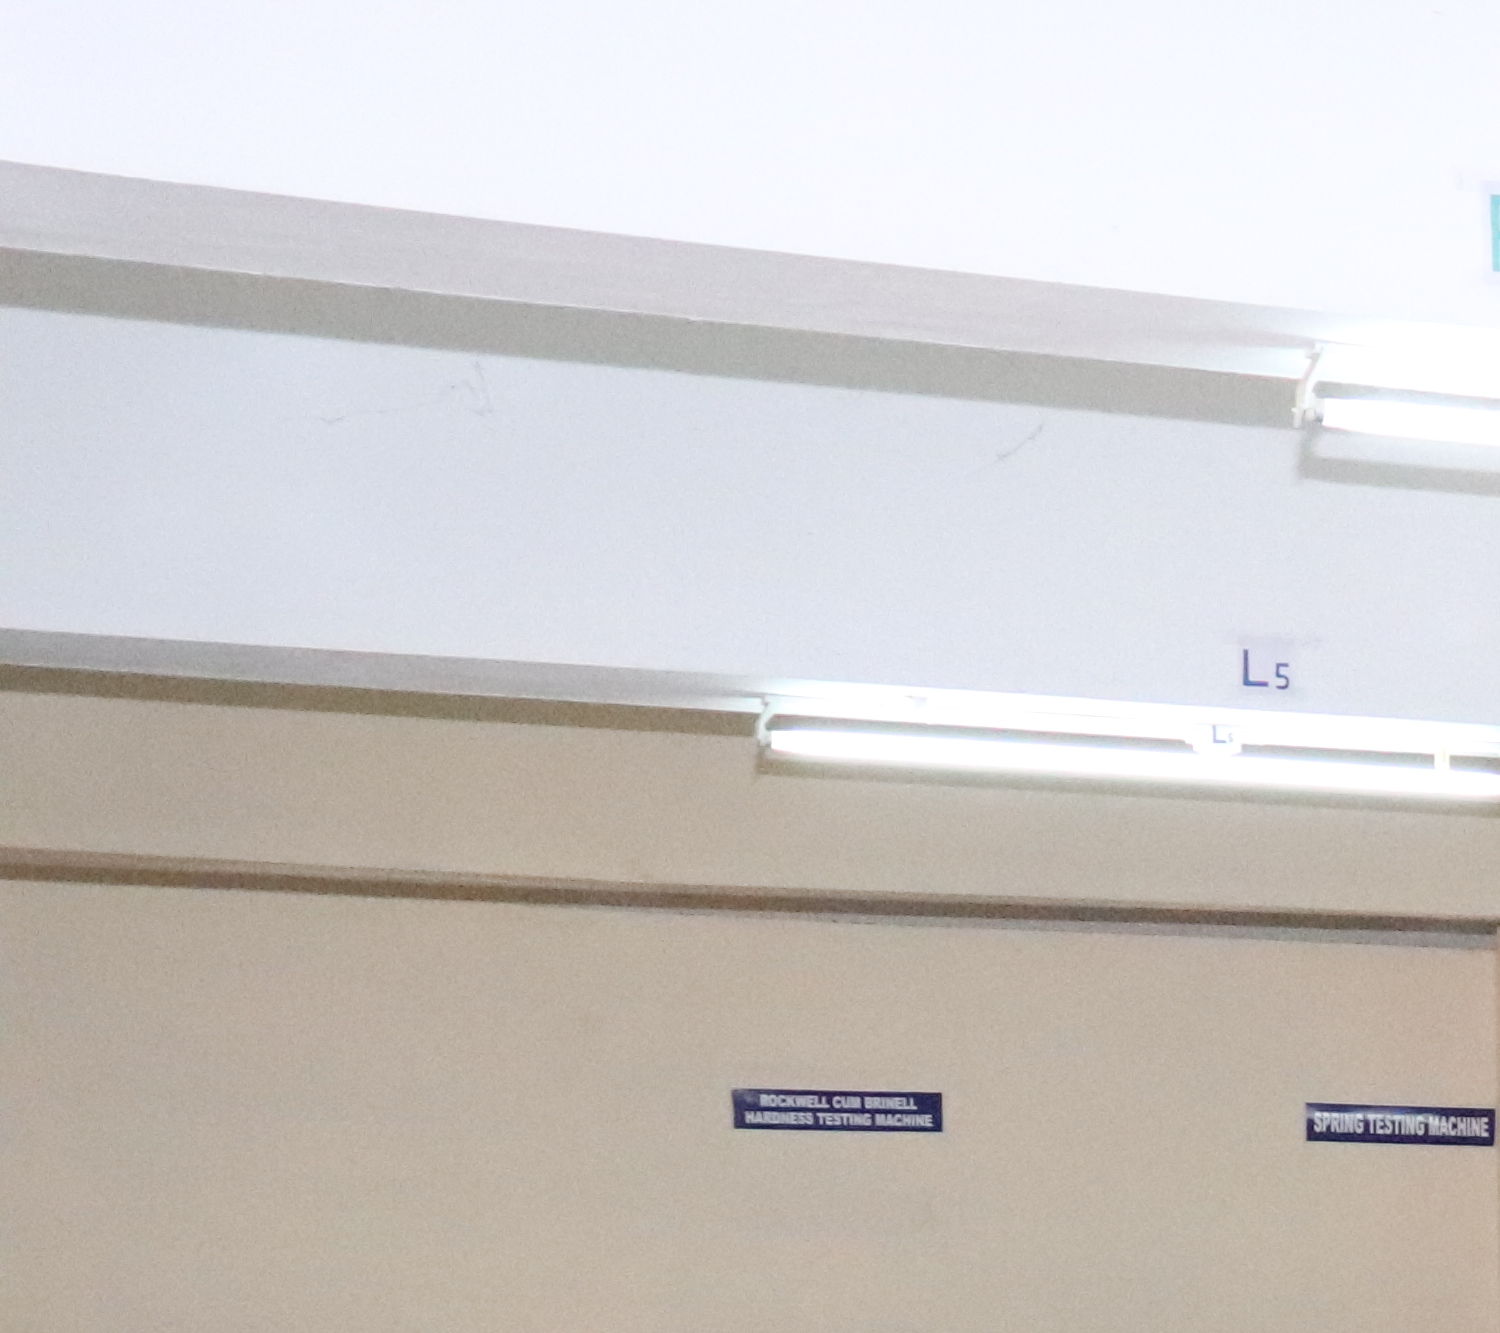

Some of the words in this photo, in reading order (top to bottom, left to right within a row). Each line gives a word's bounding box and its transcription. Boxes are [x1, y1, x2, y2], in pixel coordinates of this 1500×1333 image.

[1243, 648, 1290, 690] L5
[759, 1094, 830, 1109] ROCKWELL
[832, 1095, 862, 1109] CUM
[864, 1096, 918, 1110] BRINELL
[744, 1110, 814, 1125] HARDNESS
[816, 1112, 872, 1126] TESTING
[874, 1113, 934, 1127] MACHINE
[1313, 1111, 1365, 1134] SPRING
[1366, 1113, 1425, 1136] TESTING
[1427, 1115, 1490, 1137] MACHINE
